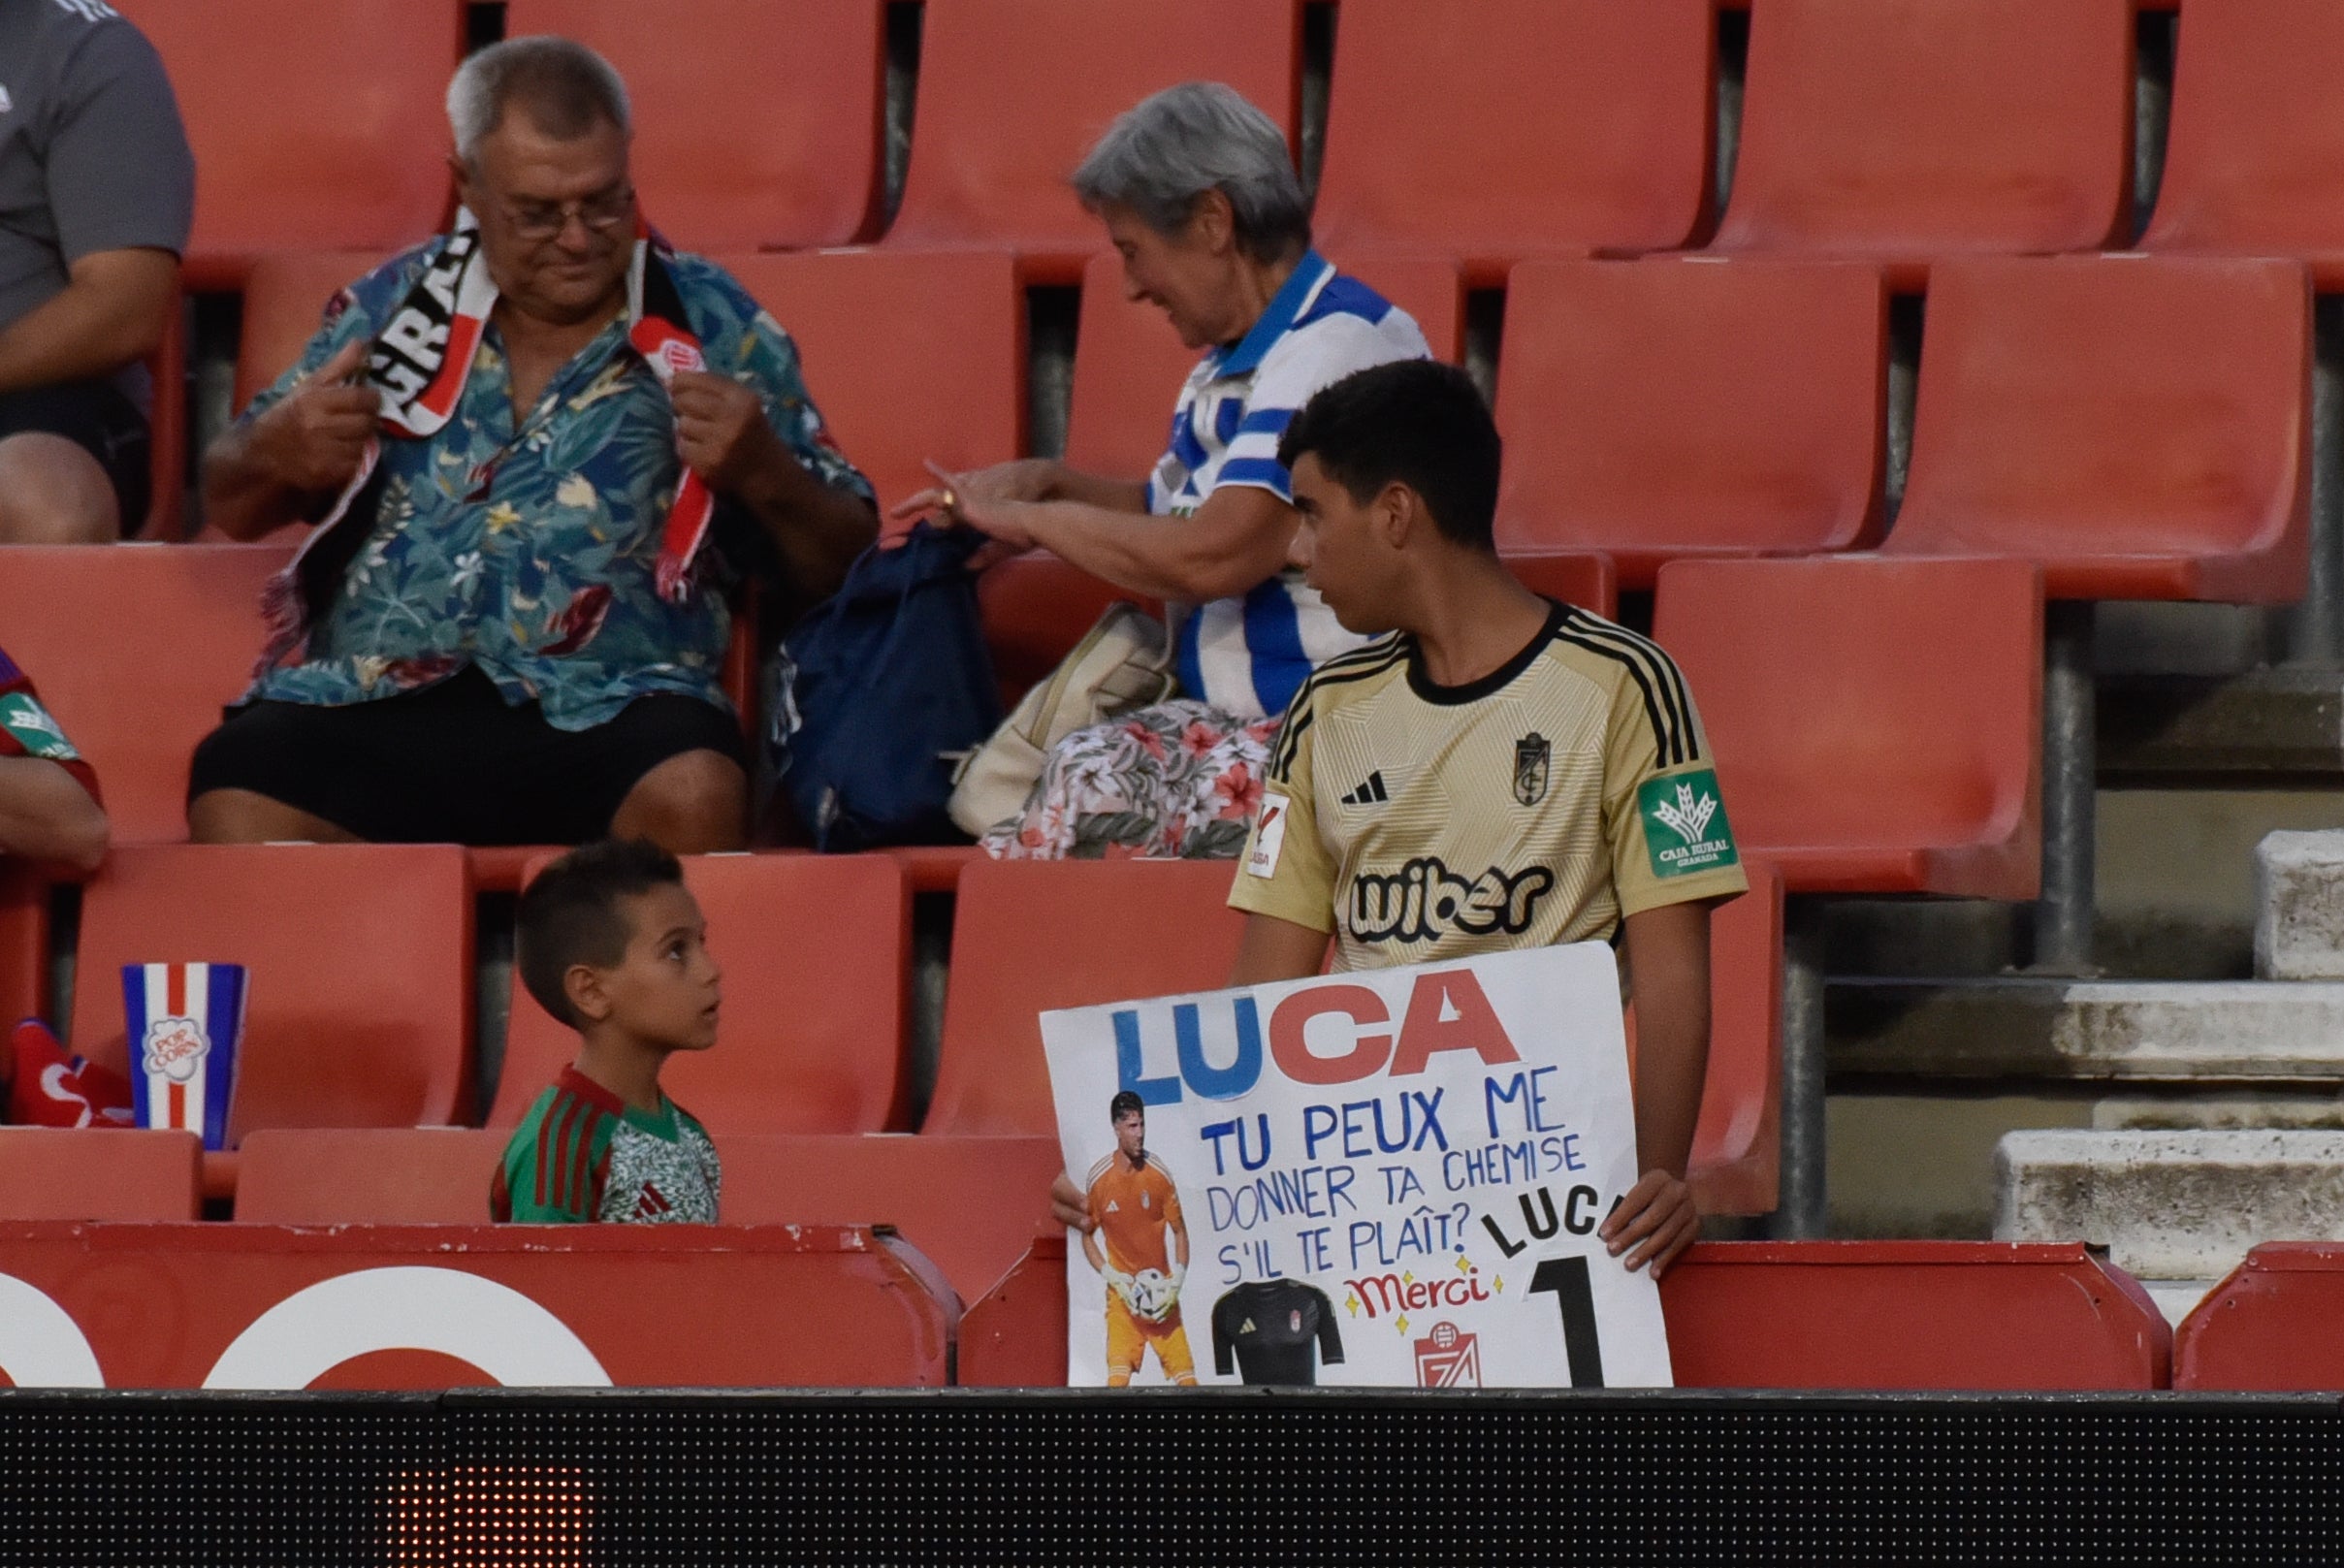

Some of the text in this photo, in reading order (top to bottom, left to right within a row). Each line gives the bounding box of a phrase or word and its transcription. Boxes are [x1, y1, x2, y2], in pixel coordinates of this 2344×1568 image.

[1677, 853, 1719, 867] GRANADA
[1690, 840, 1729, 855] RURAL
[1349, 856, 1555, 944] wiber
[156, 1029, 187, 1052] POP
[1112, 969, 1522, 1106] LUCA
[1201, 1065, 1565, 1175] TU PEUX ME
[1206, 1134, 1587, 1232] DONNER TA CHEMISE
[1218, 1202, 1470, 1285] S'IL TE PLAÎT?
[1528, 1255, 1605, 1389] 1
